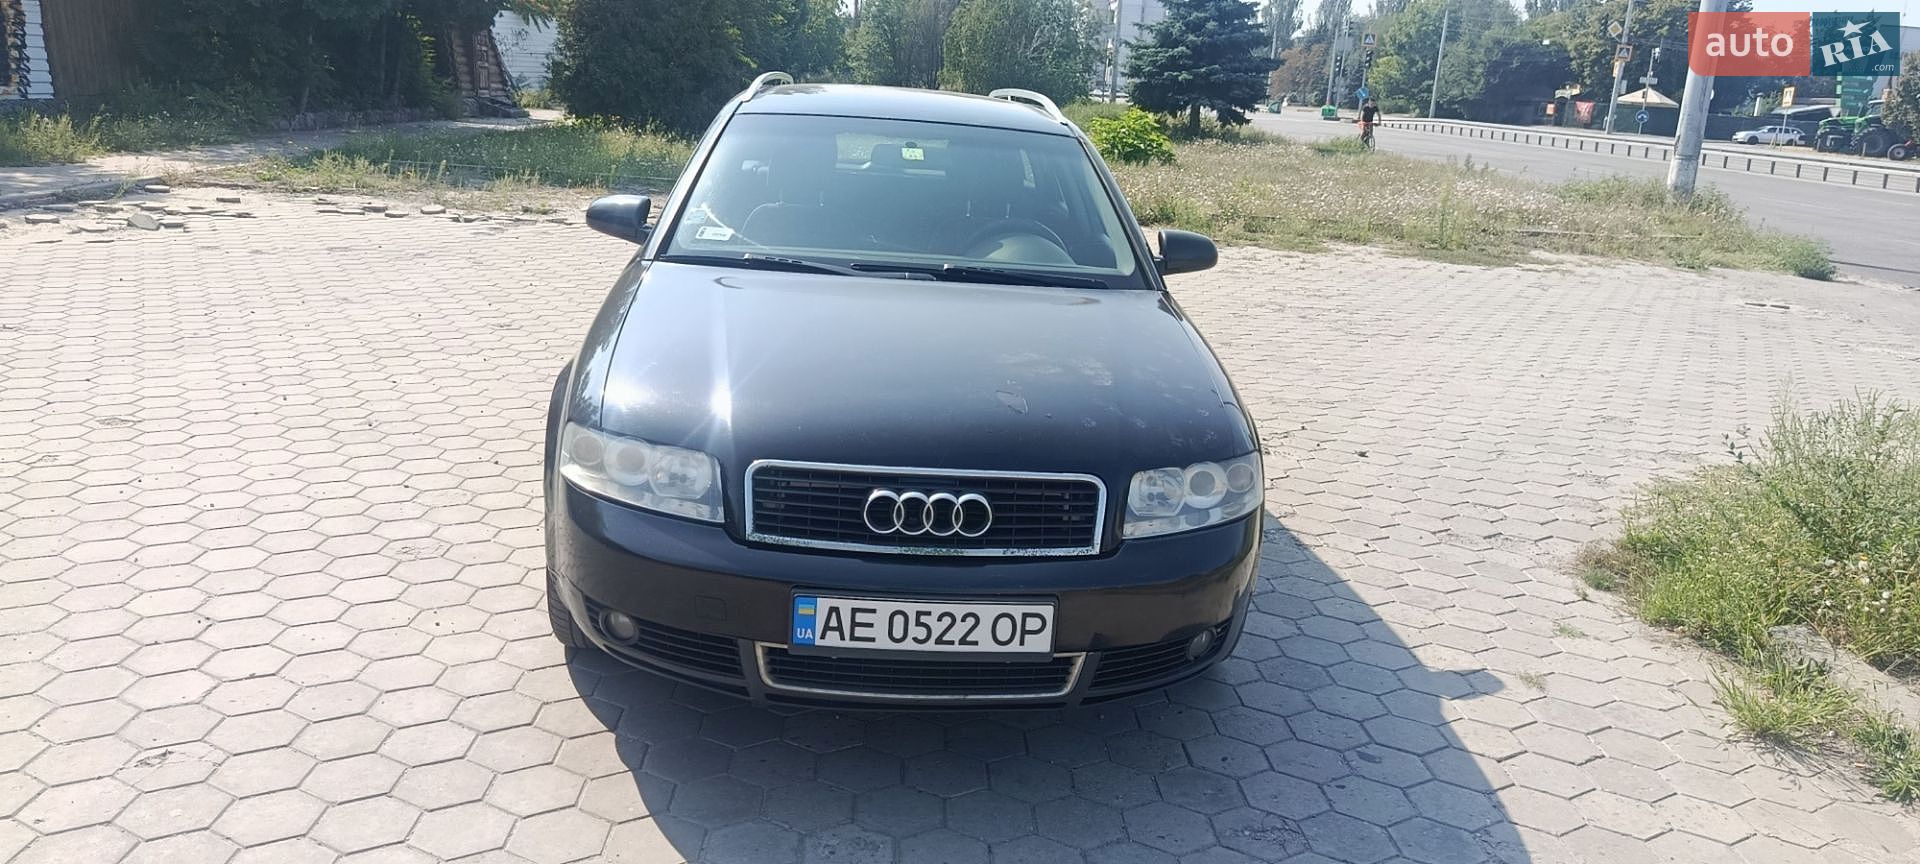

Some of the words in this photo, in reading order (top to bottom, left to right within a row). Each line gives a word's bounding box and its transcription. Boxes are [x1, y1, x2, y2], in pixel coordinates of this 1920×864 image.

[796, 627, 813, 640] UA
[819, 606, 877, 643] AE
[887, 609, 980, 646] 0522
[990, 612, 1048, 647] OP
